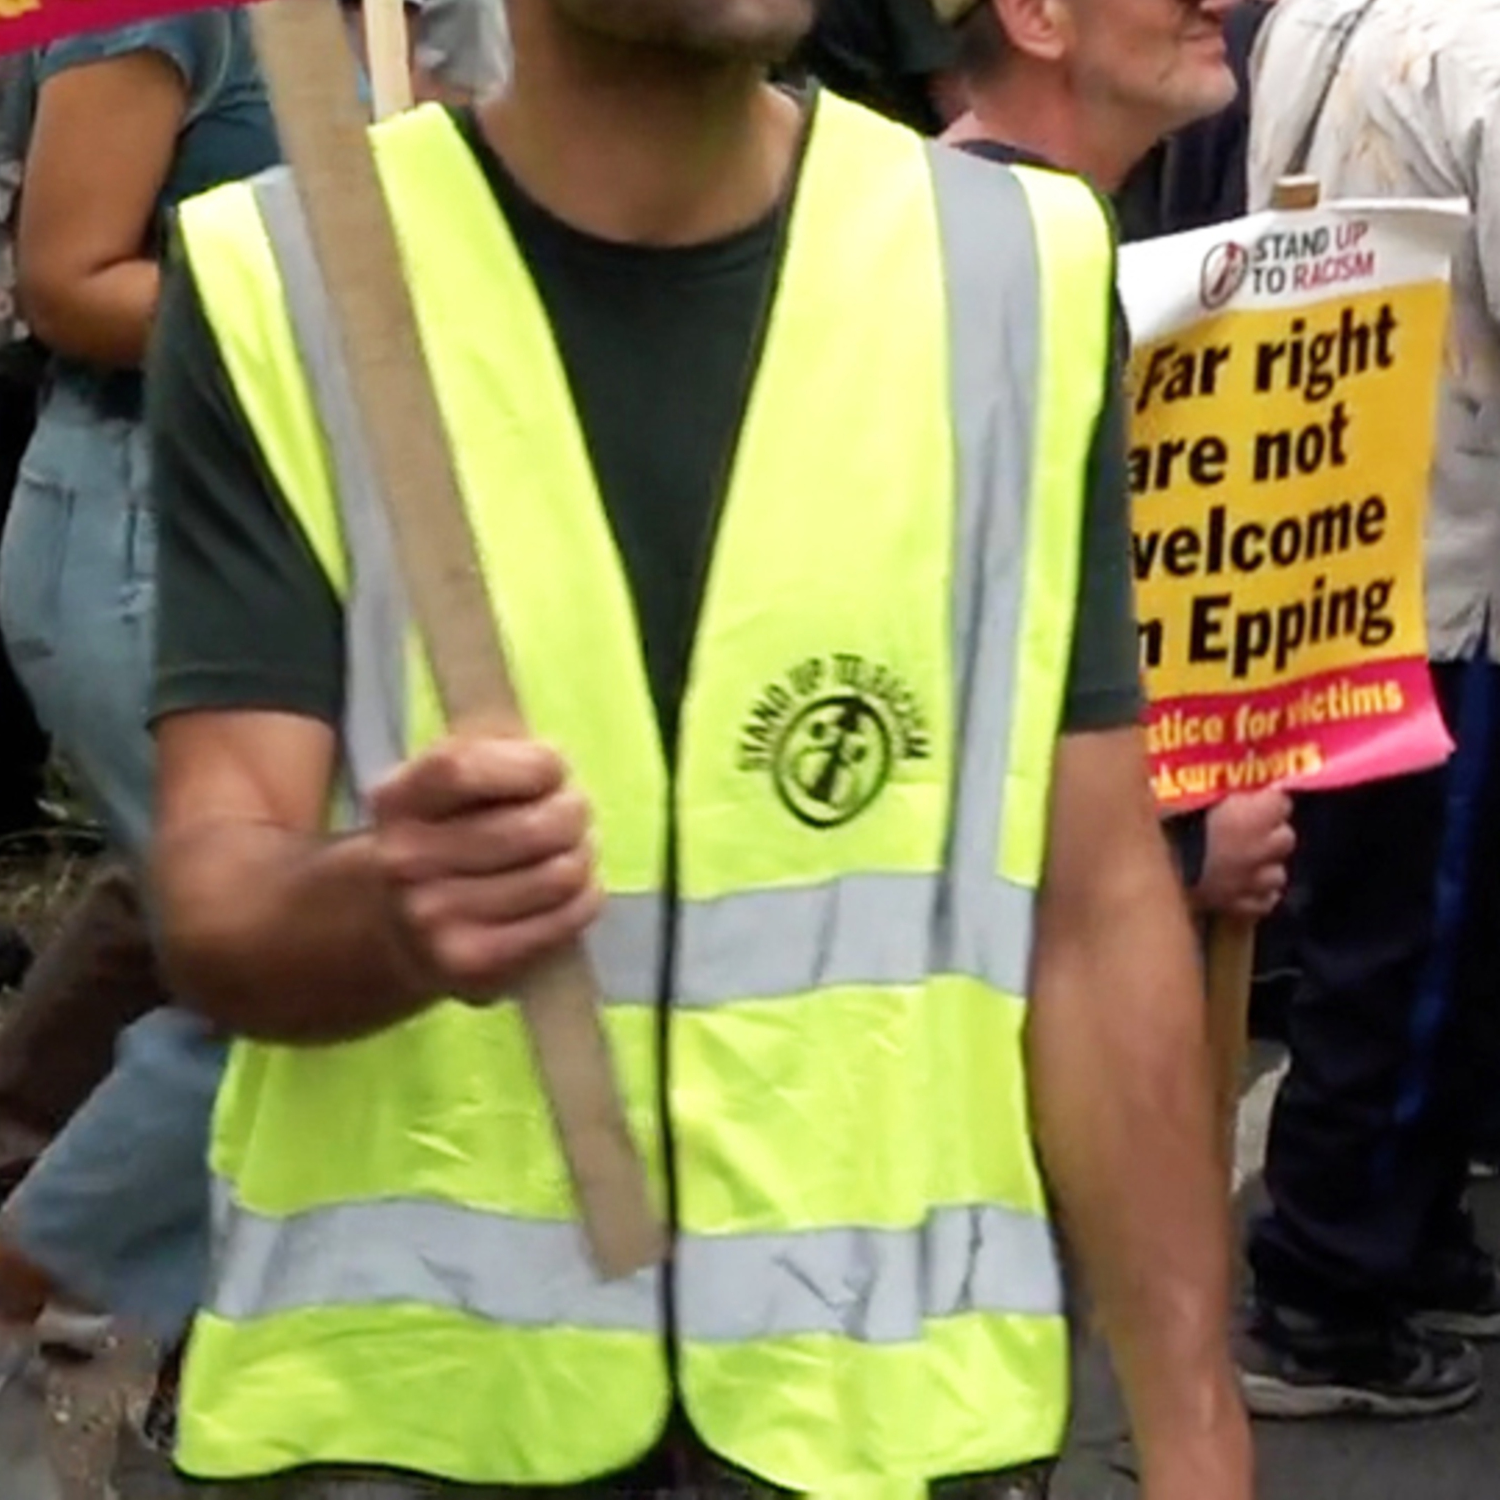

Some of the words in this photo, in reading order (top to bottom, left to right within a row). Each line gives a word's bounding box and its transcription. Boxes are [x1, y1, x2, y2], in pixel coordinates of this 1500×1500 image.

[1252, 226, 1330, 263] STAND
[1335, 220, 1370, 250] UP
[1252, 266, 1287, 295] TO
[1292, 250, 1376, 292] RACISM
[1136, 340, 1231, 414] Far
[1253, 304, 1399, 403] right
[1127, 435, 1229, 494] are
[1252, 401, 1350, 483] not
[1187, 574, 1396, 679] Epping
[1145, 708, 1224, 754] stice
[1235, 703, 1281, 743] for
